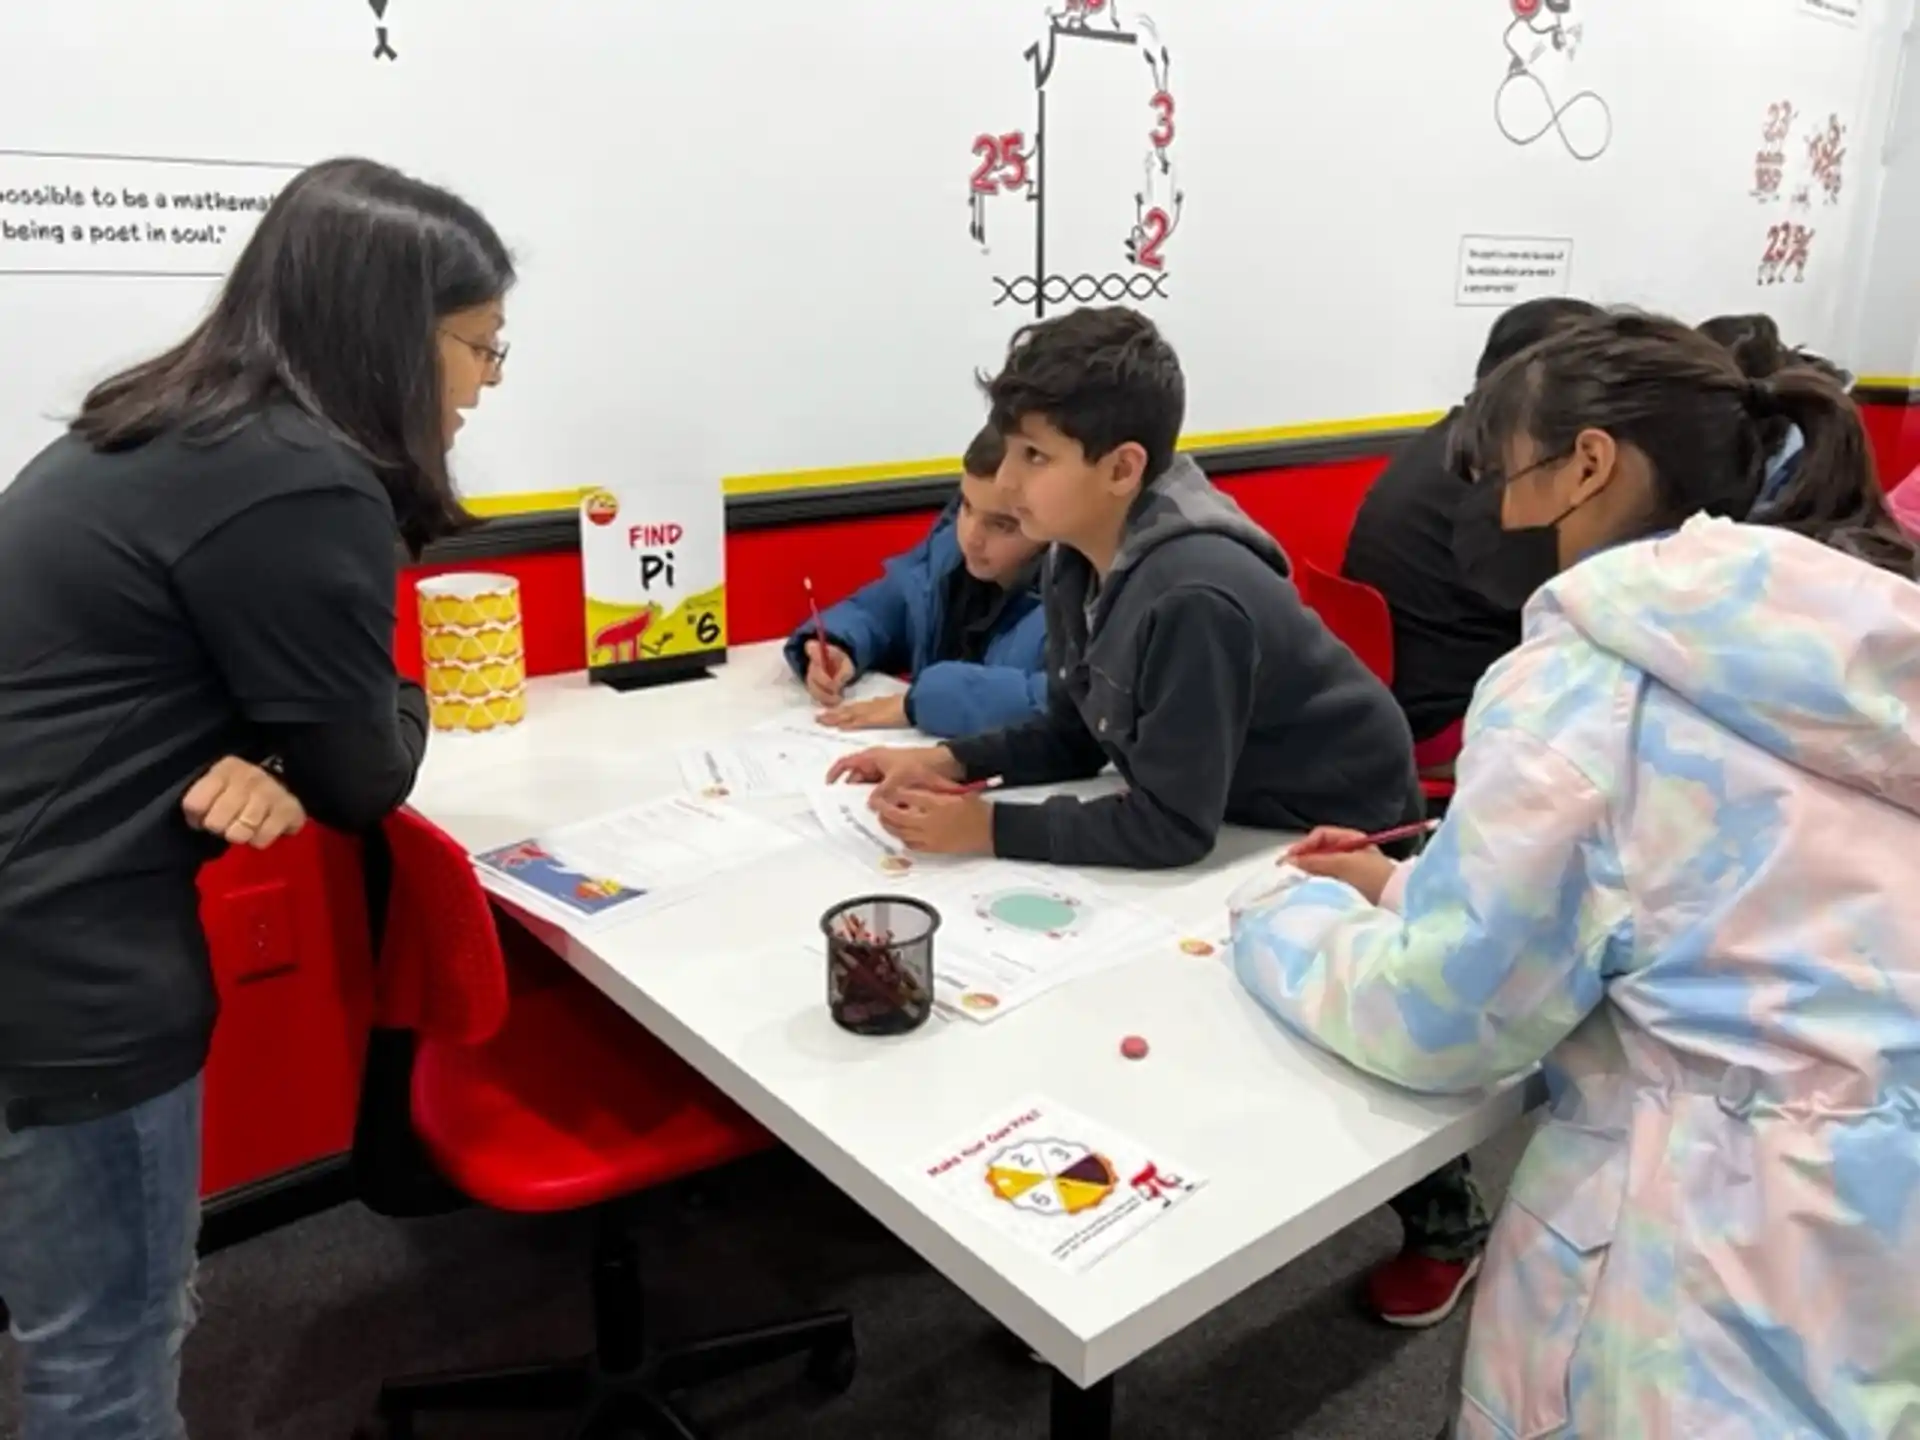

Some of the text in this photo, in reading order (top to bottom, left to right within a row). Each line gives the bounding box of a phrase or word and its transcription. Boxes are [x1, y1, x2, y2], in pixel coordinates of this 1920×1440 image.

[1149, 91, 1176, 149] 3
[969, 131, 1029, 196] 25
[92, 186, 117, 209] to
[122, 188, 149, 209] be
[155, 191, 168, 209] a
[2, 219, 65, 245] being
[71, 224, 84, 241] a
[90, 223, 141, 245] poet
[146, 221, 167, 242] in
[1136, 206, 1170, 271] 2
[628, 523, 684, 550] FIND
[640, 549, 675, 591] Pi
